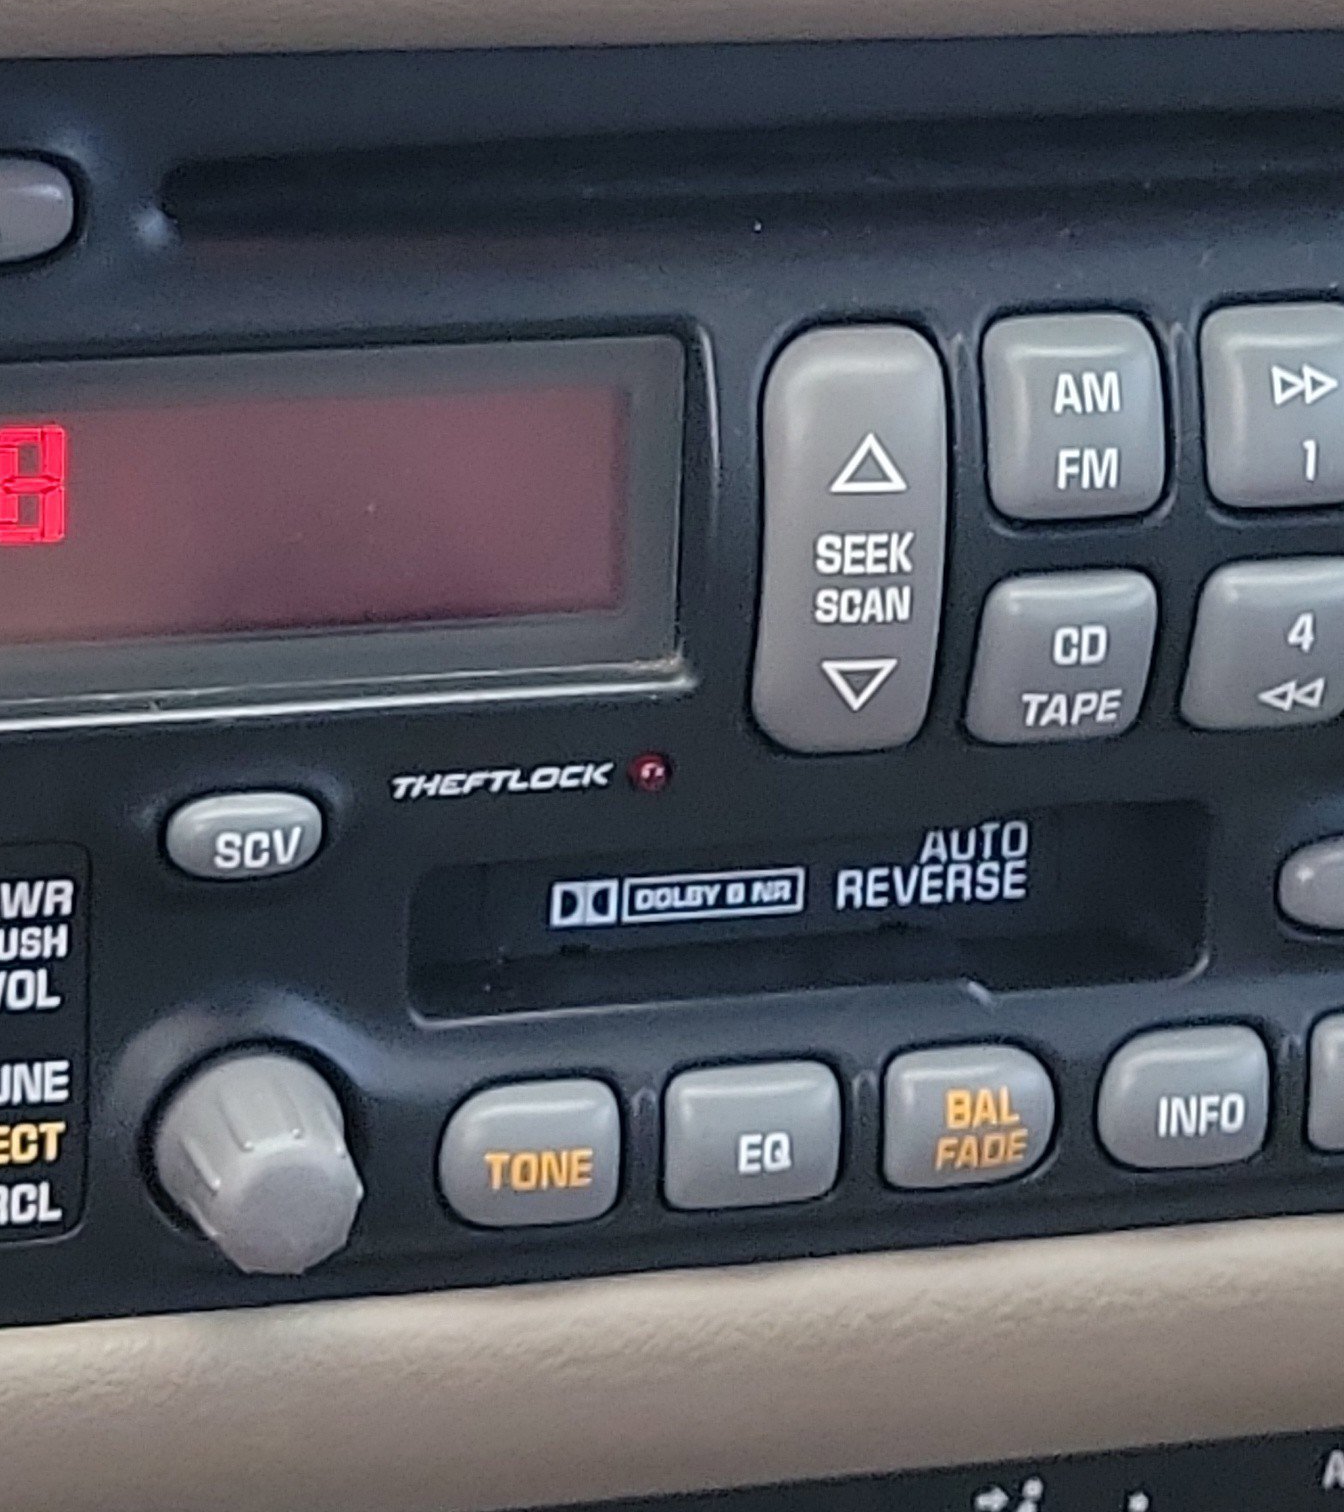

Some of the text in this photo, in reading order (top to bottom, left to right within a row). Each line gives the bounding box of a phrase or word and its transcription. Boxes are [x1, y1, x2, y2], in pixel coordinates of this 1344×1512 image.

[1054, 371, 1121, 414] AM
[1057, 448, 1119, 489] FM
[1302, 440, 1318, 481] 1
[815, 532, 915, 575] SEEK
[814, 586, 911, 624] SCAN
[1053, 625, 1108, 666] CD
[1287, 613, 1315, 652] 4
[1021, 688, 1123, 727] TAPE
[390, 762, 616, 800] THEFTLOCK
[213, 827, 303, 869] SCV
[920, 821, 1029, 864] AUTO
[634, 884, 718, 912] DOLBY
[750, 879, 792, 903] NR
[836, 859, 1028, 910] REVERSE
[946, 1088, 1020, 1129] BAL
[1157, 1093, 1246, 1138] INFO
[484, 1148, 594, 1190] TONE
[738, 1132, 792, 1173] EQ
[935, 1128, 1029, 1171] FADE
